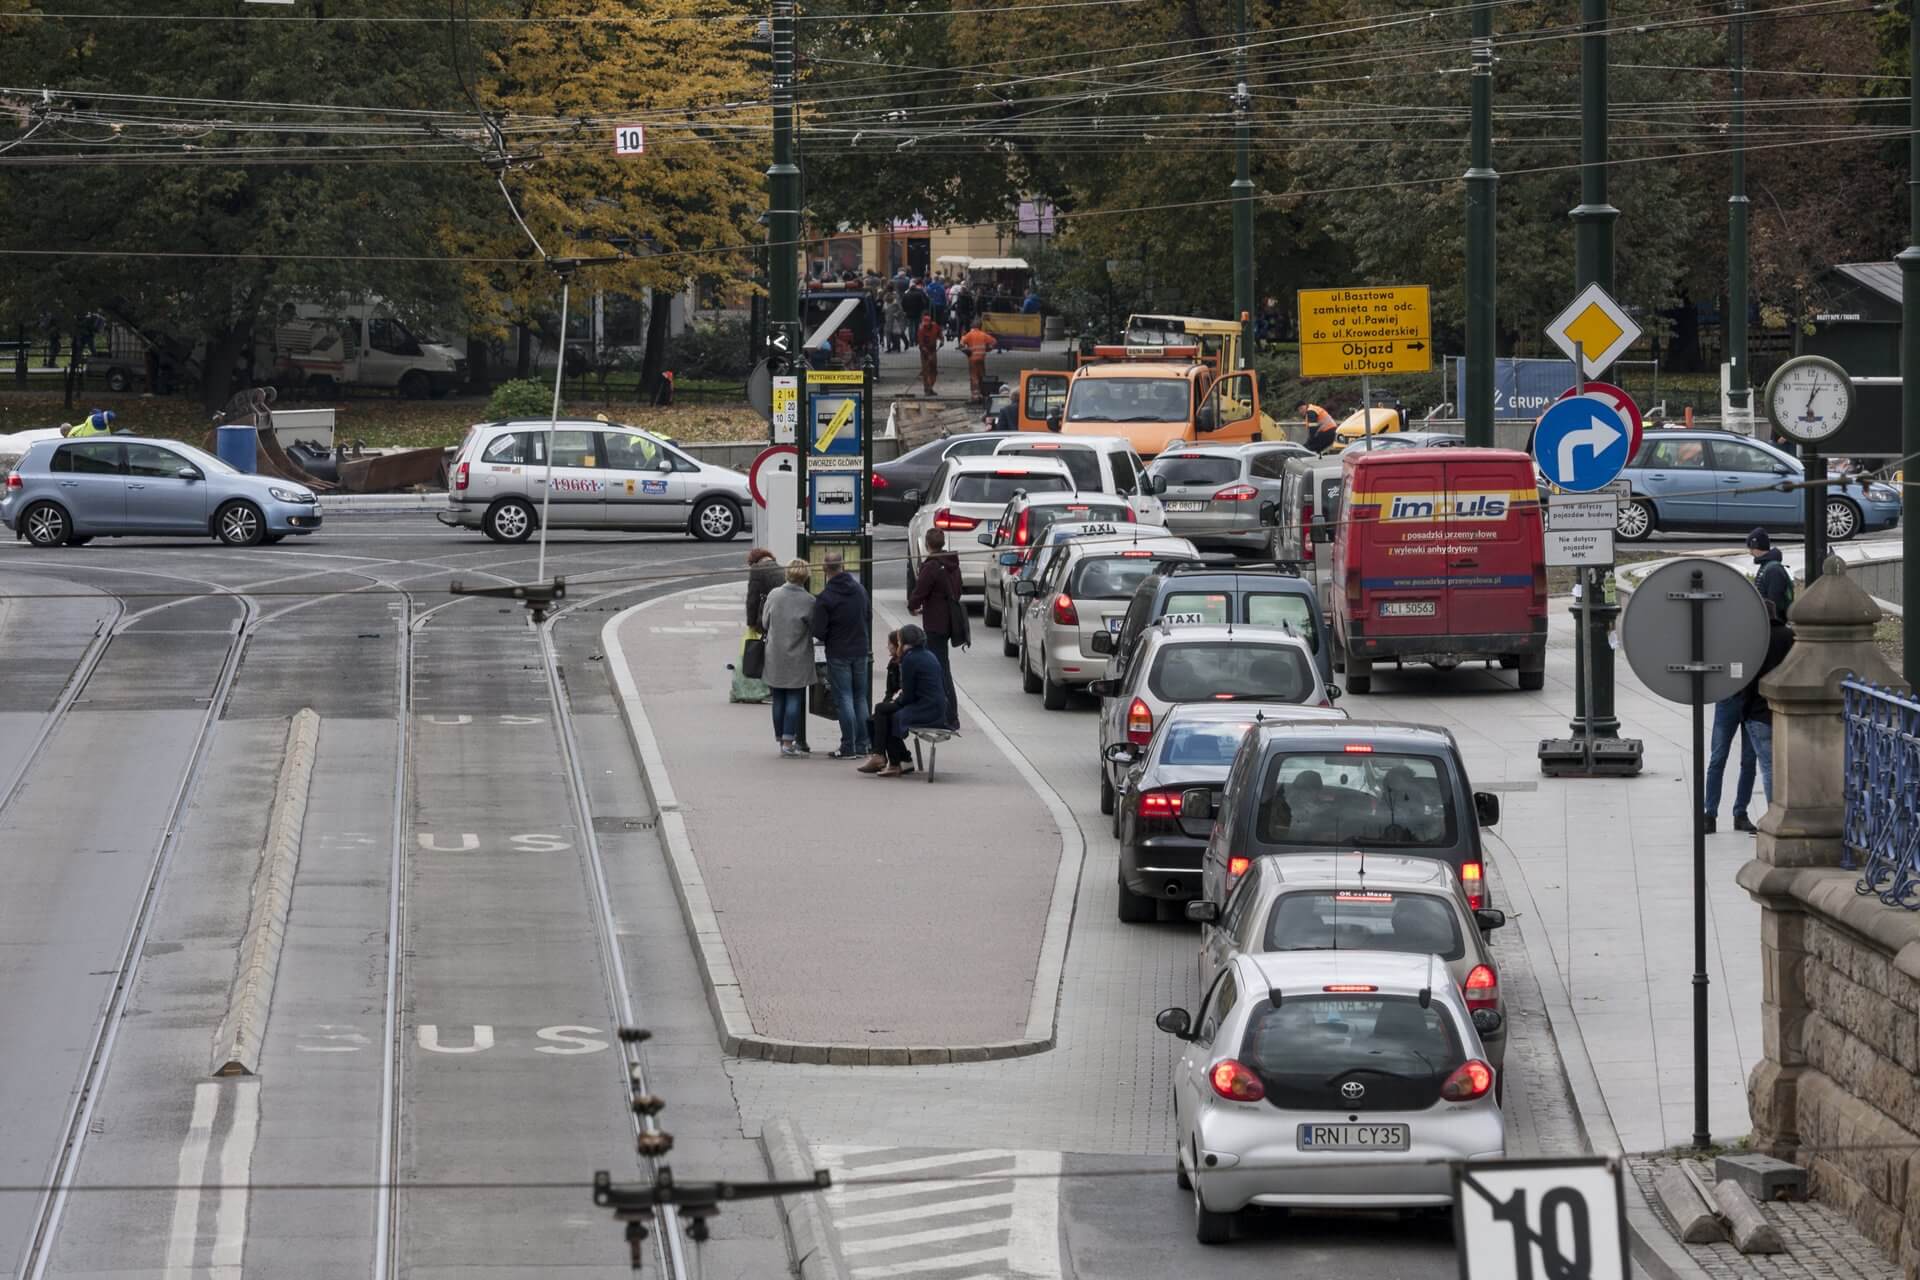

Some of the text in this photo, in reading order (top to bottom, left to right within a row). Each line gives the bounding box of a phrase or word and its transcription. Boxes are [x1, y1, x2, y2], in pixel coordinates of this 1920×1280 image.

[620, 130, 640, 150] 10
[1331, 291, 1394, 302] ul.Basztowa
[1313, 302, 1417, 315] zamknięta na odc.
[1332, 314, 1399, 326] od ul.Pawiej
[1312, 326, 1419, 339] do ul.Krowoderskiej
[1342, 342, 1393, 357] Objazd
[1343, 360, 1393, 371] ul.Długa
[778, 390, 794, 399] 2 14
[777, 401, 795, 411] 4 20
[776, 414, 795, 422] 10 52
[808, 457, 862, 467] DWORZEC GŁÓWNY
[1081, 523, 1110, 533] TAXI
[1407, 530, 1443, 541] posadzki
[1573, 535, 1597, 543] dotyczy
[1393, 544, 1478, 555] wylewki anhydrytowe
[1166, 614, 1201, 624] TAXI
[1314, 1127, 1401, 1145] RNI CY35
[1491, 1186, 1593, 1280] 10
